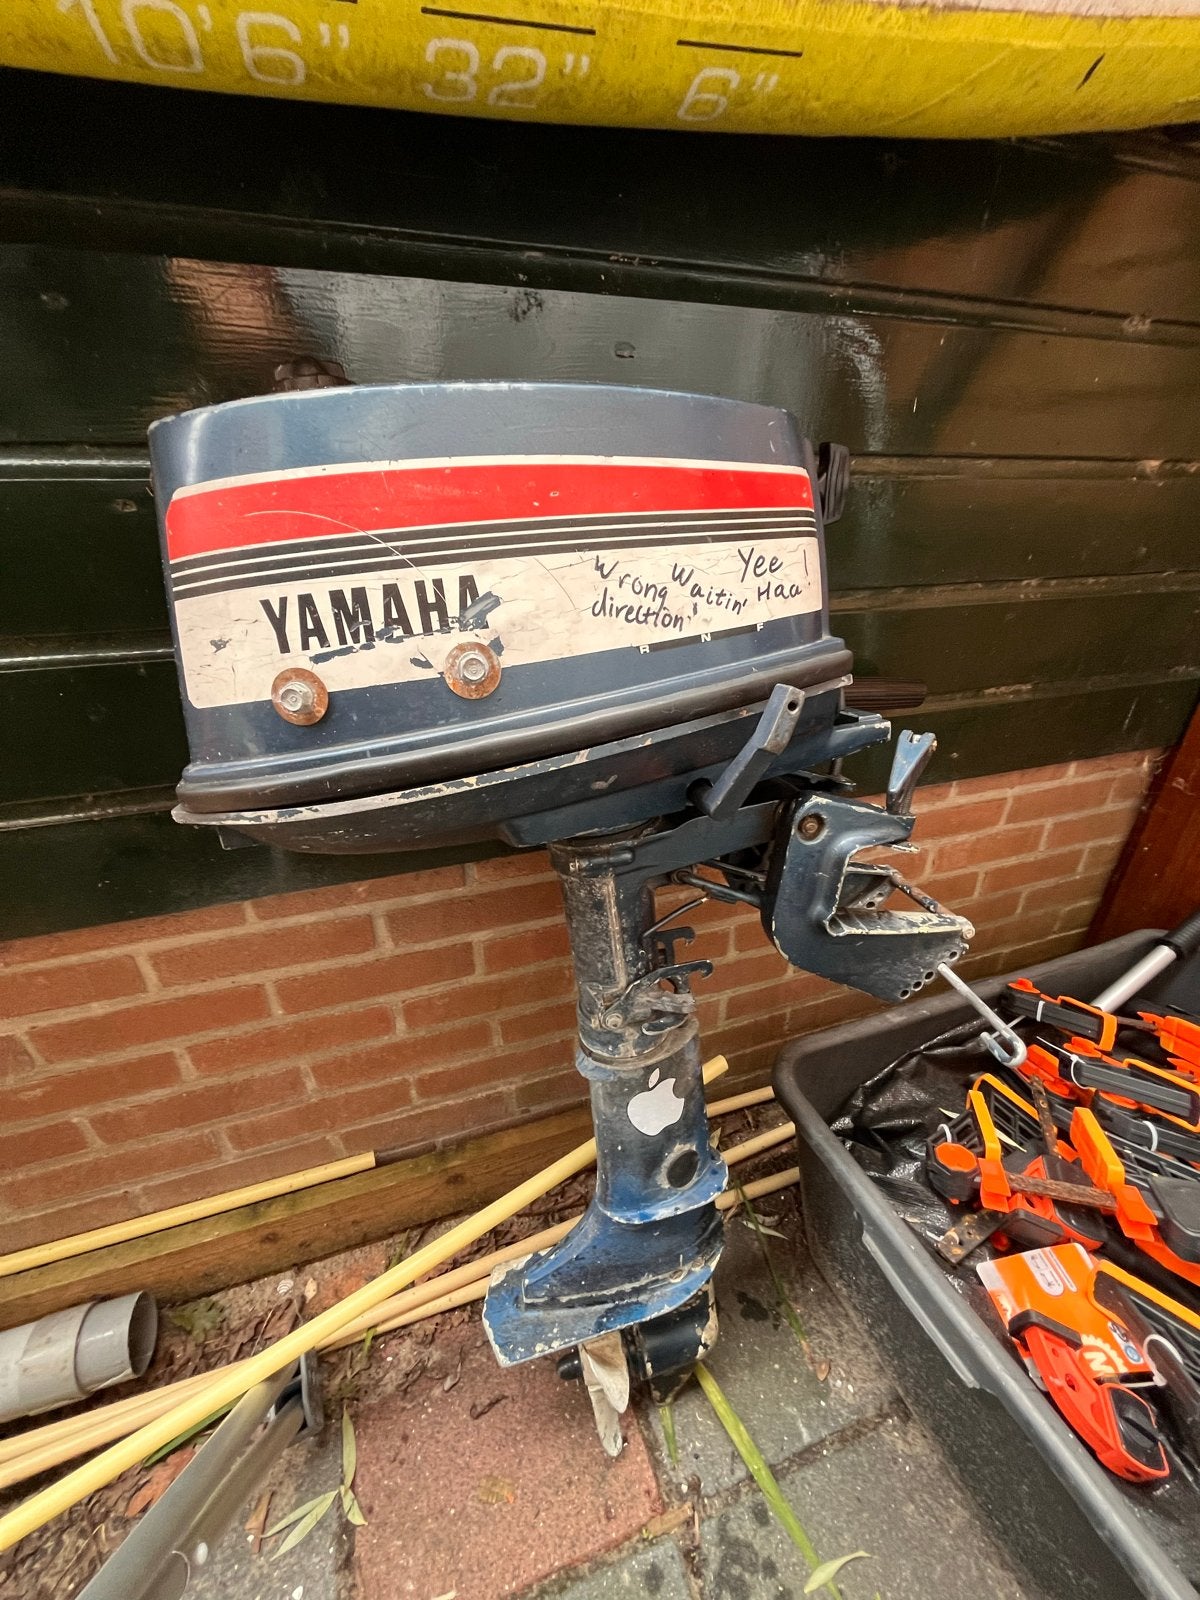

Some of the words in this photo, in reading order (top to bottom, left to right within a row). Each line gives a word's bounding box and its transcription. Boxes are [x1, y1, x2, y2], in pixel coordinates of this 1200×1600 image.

[423, 37, 591, 110] 32"
[676, 66, 779, 122] 6"
[594, 554, 668, 614] Wrong
[738, 547, 783, 582] Yee
[259, 574, 490, 654] YAMAHA
[639, 644, 650, 655] R
[700, 632, 711, 643] N
[756, 622, 765, 632] F
